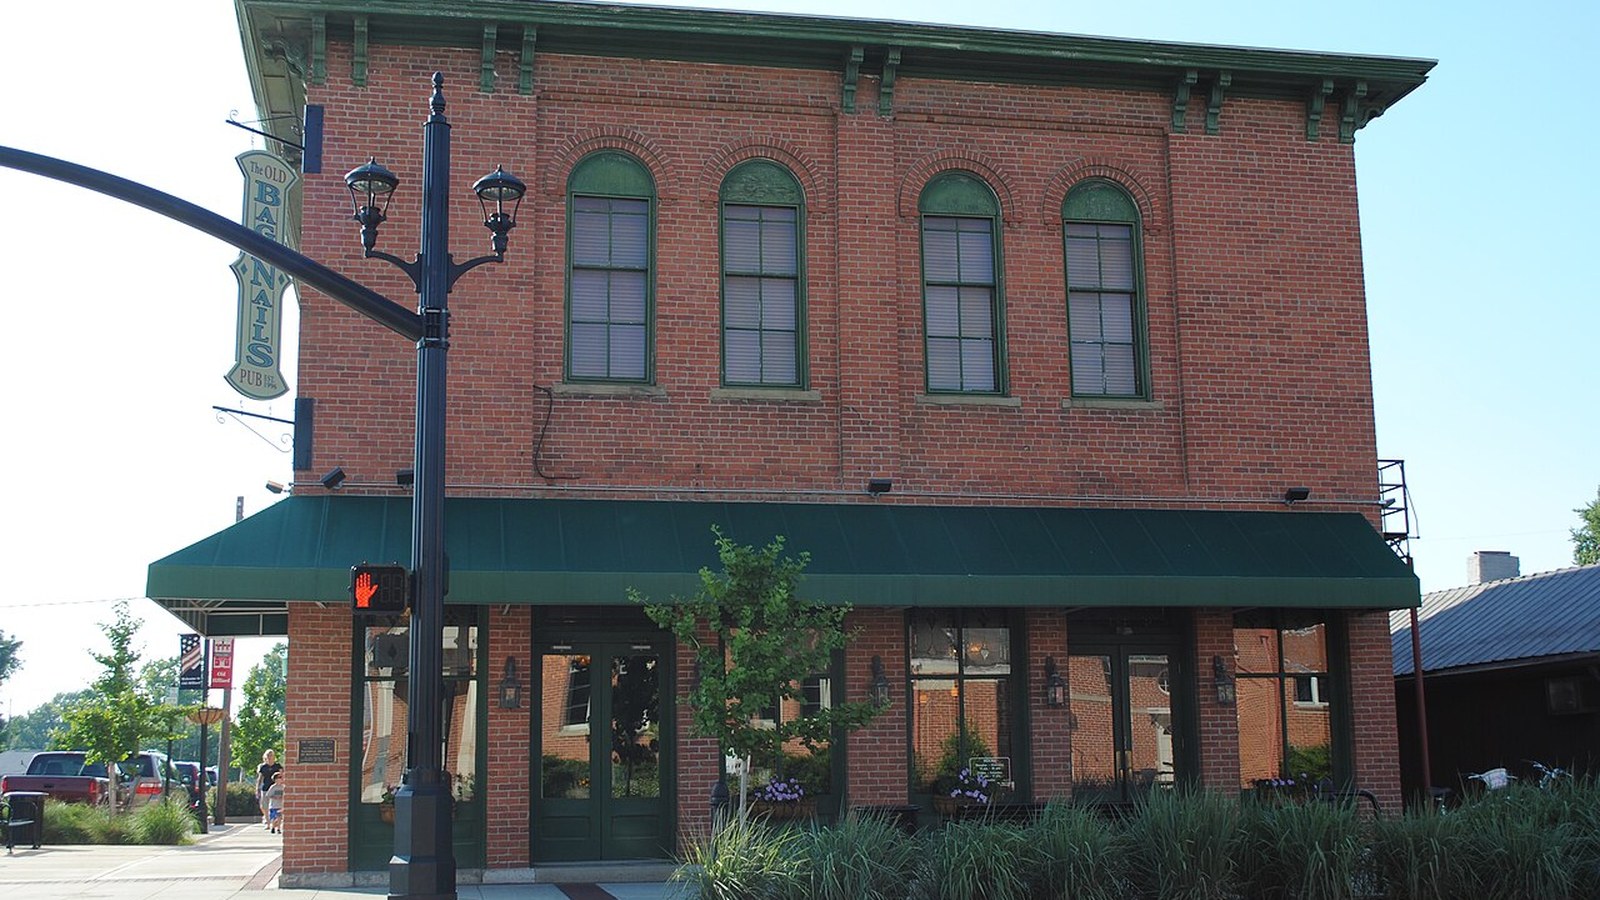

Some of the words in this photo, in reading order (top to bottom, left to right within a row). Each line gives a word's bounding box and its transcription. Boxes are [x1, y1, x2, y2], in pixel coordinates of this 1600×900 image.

[250, 161, 263, 175] The
[264, 165, 287, 183] OLD
[246, 256, 275, 367] NAILS
[240, 368, 263, 387] PUB
